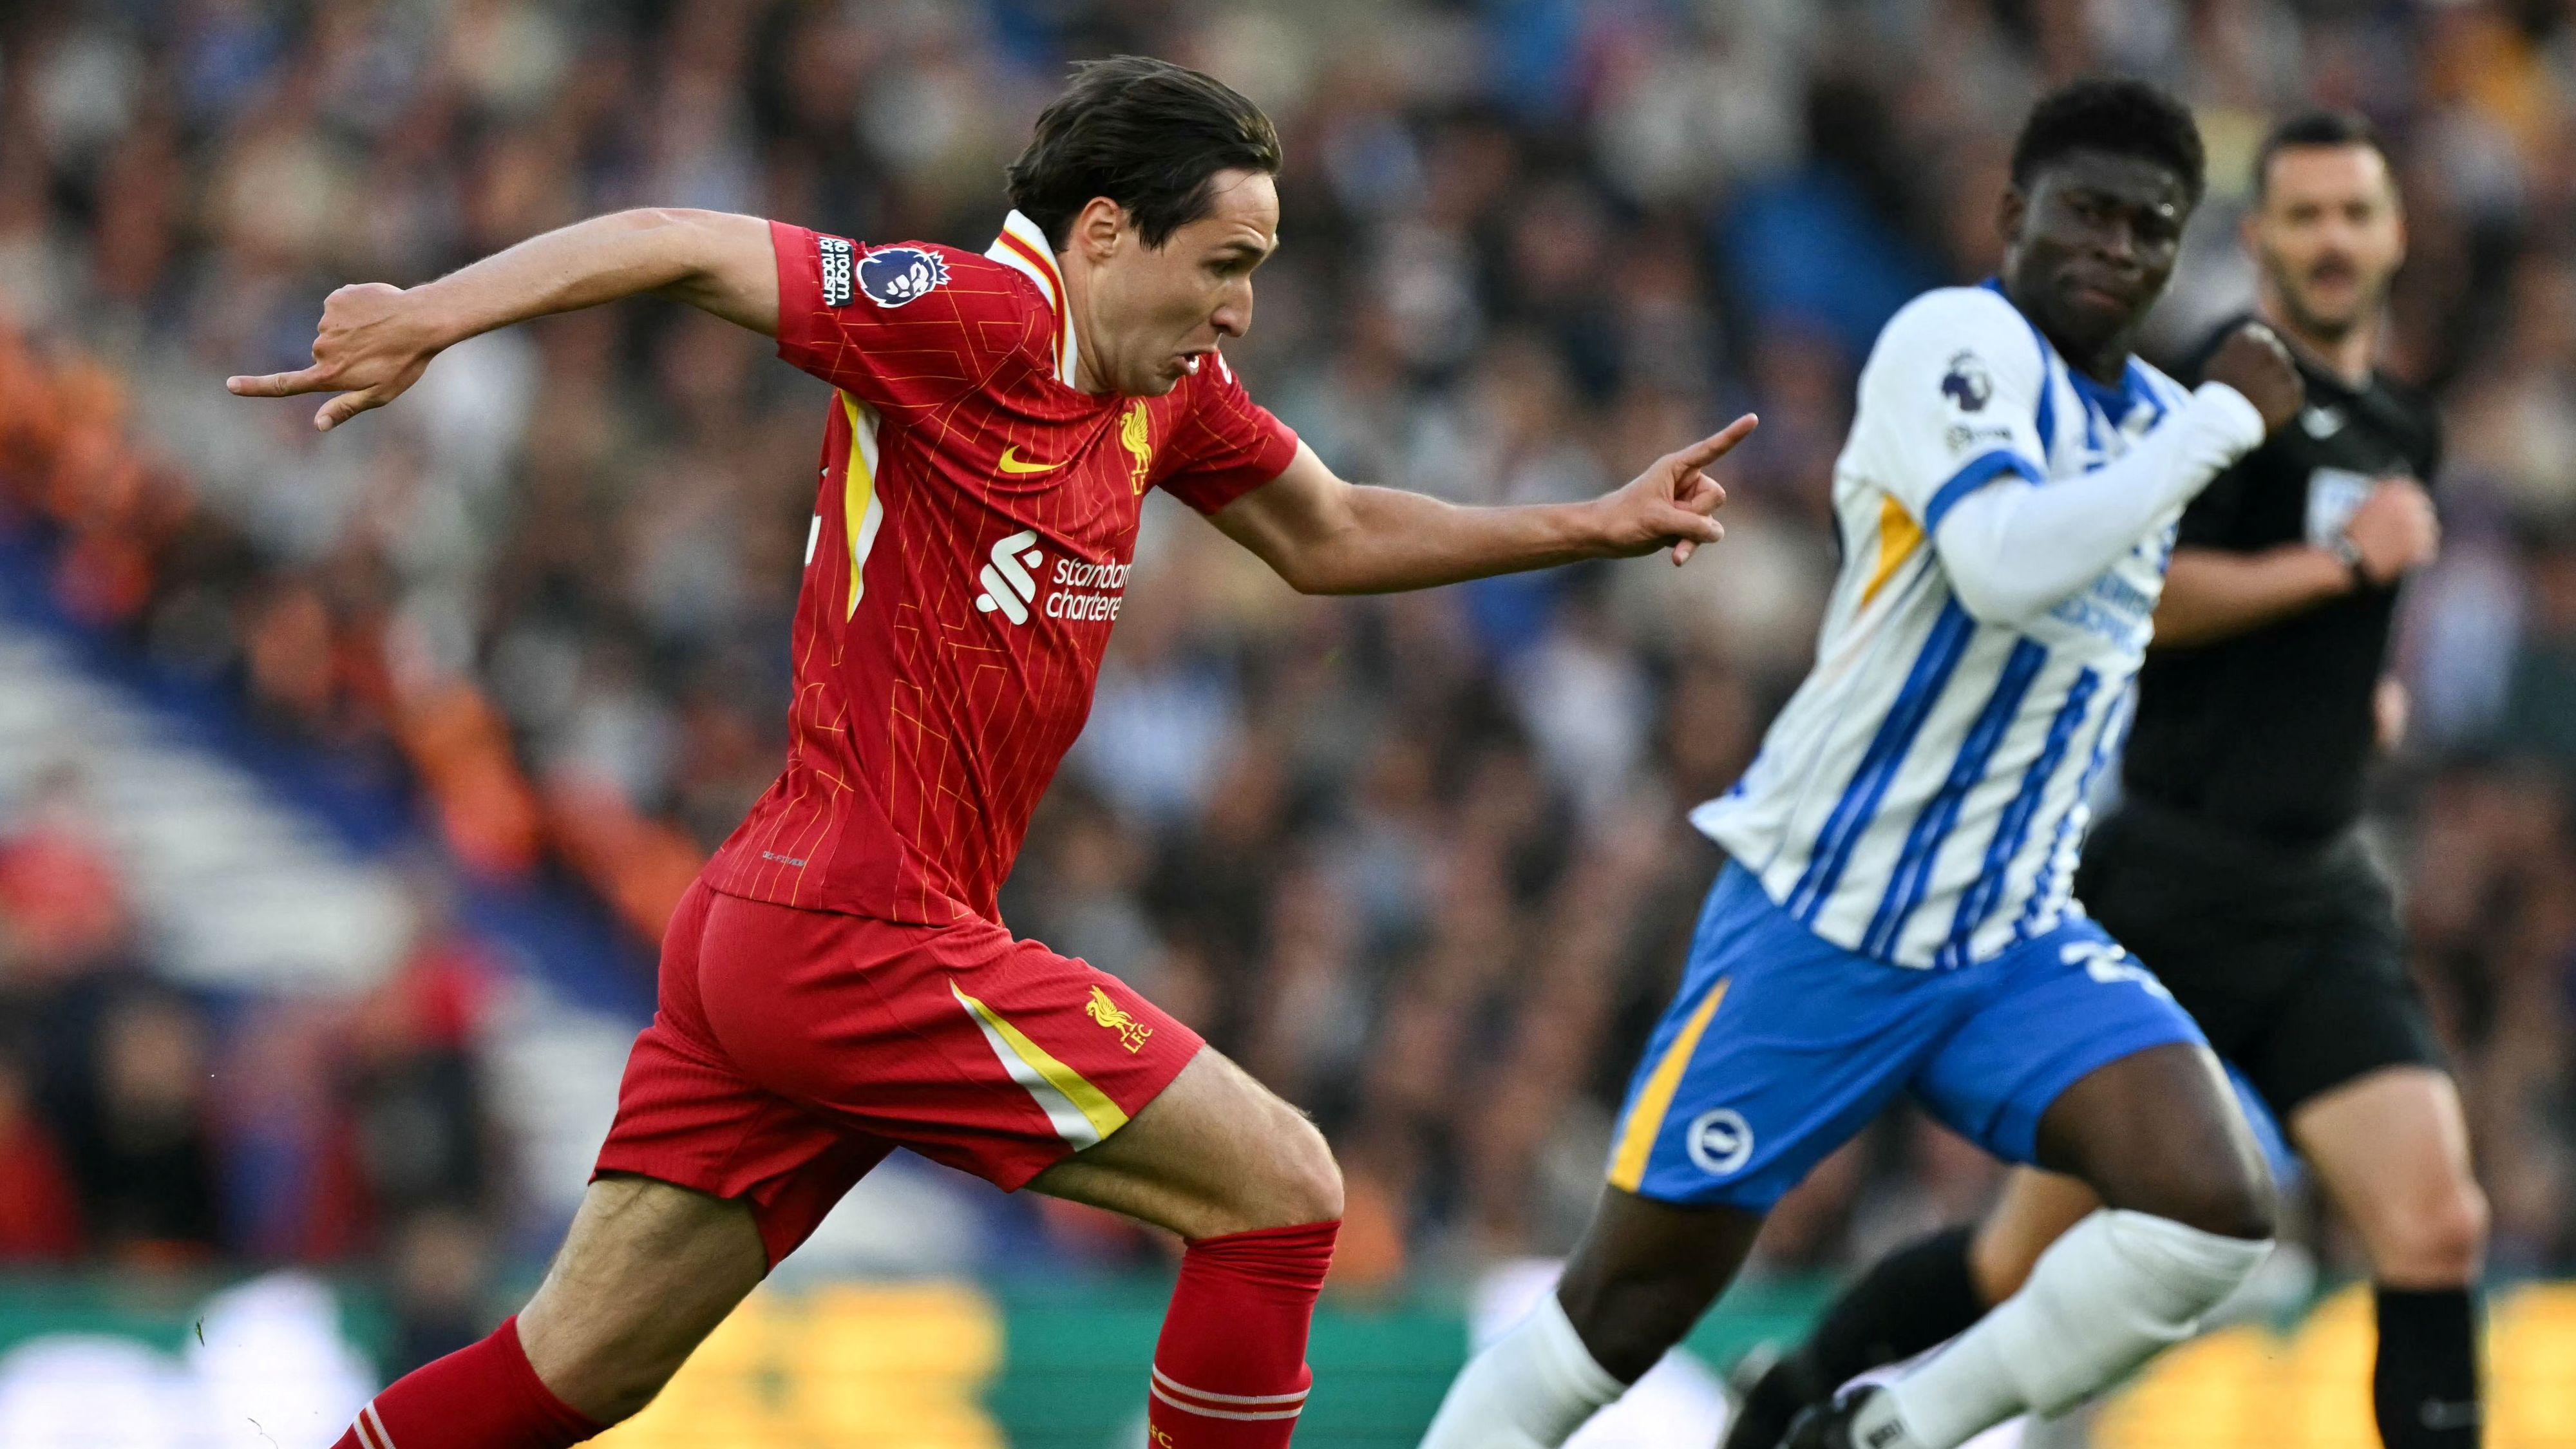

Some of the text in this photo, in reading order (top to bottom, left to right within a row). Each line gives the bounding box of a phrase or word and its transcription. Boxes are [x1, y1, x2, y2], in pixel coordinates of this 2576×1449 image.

[822, 253, 837, 306] racism
[835, 238, 851, 299] No room
[1053, 557, 1132, 589] standar
[1046, 587, 1122, 621] chartere
